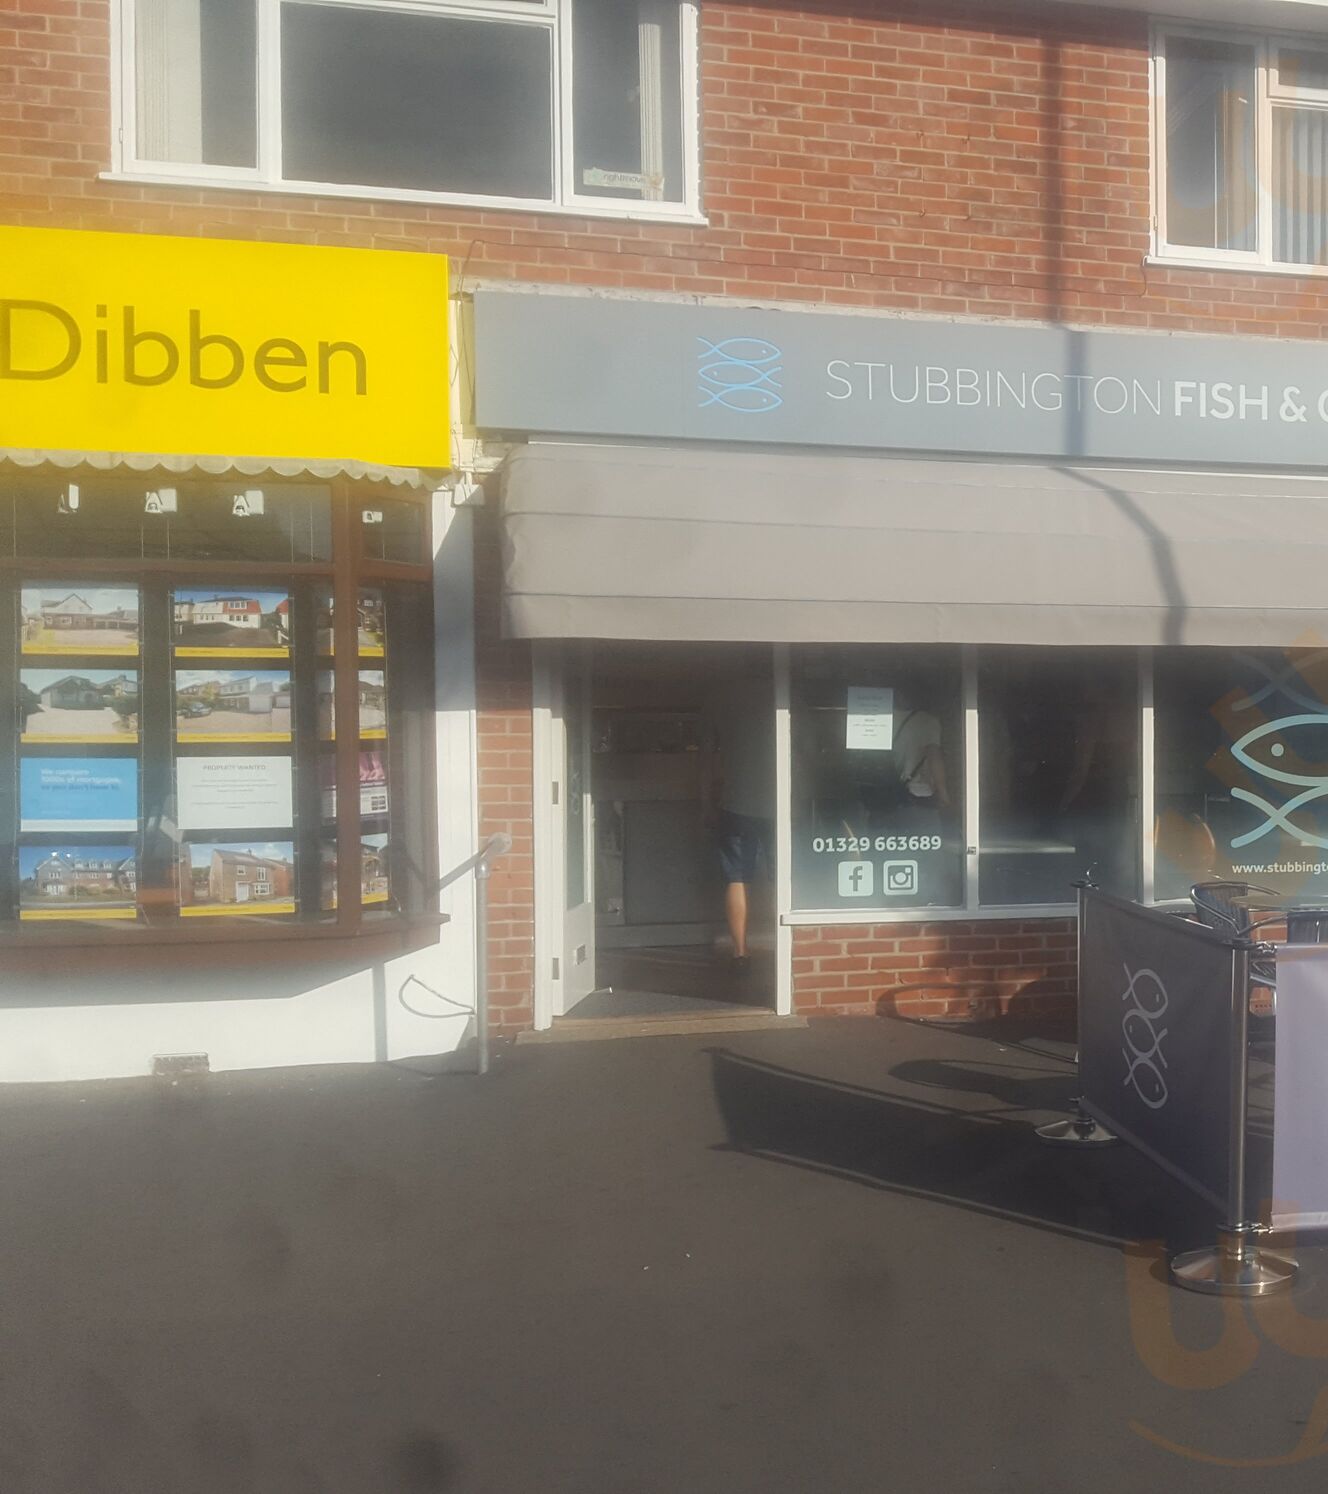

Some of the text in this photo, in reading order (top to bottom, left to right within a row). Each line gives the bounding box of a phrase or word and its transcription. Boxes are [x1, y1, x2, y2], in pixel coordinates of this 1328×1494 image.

[0, 299, 367, 396] Dibben
[825, 360, 1161, 416] STUBBINGTON
[1173, 380, 1269, 421] FISH
[1279, 387, 1308, 423] &
[813, 836, 942, 853] 01329 663689
